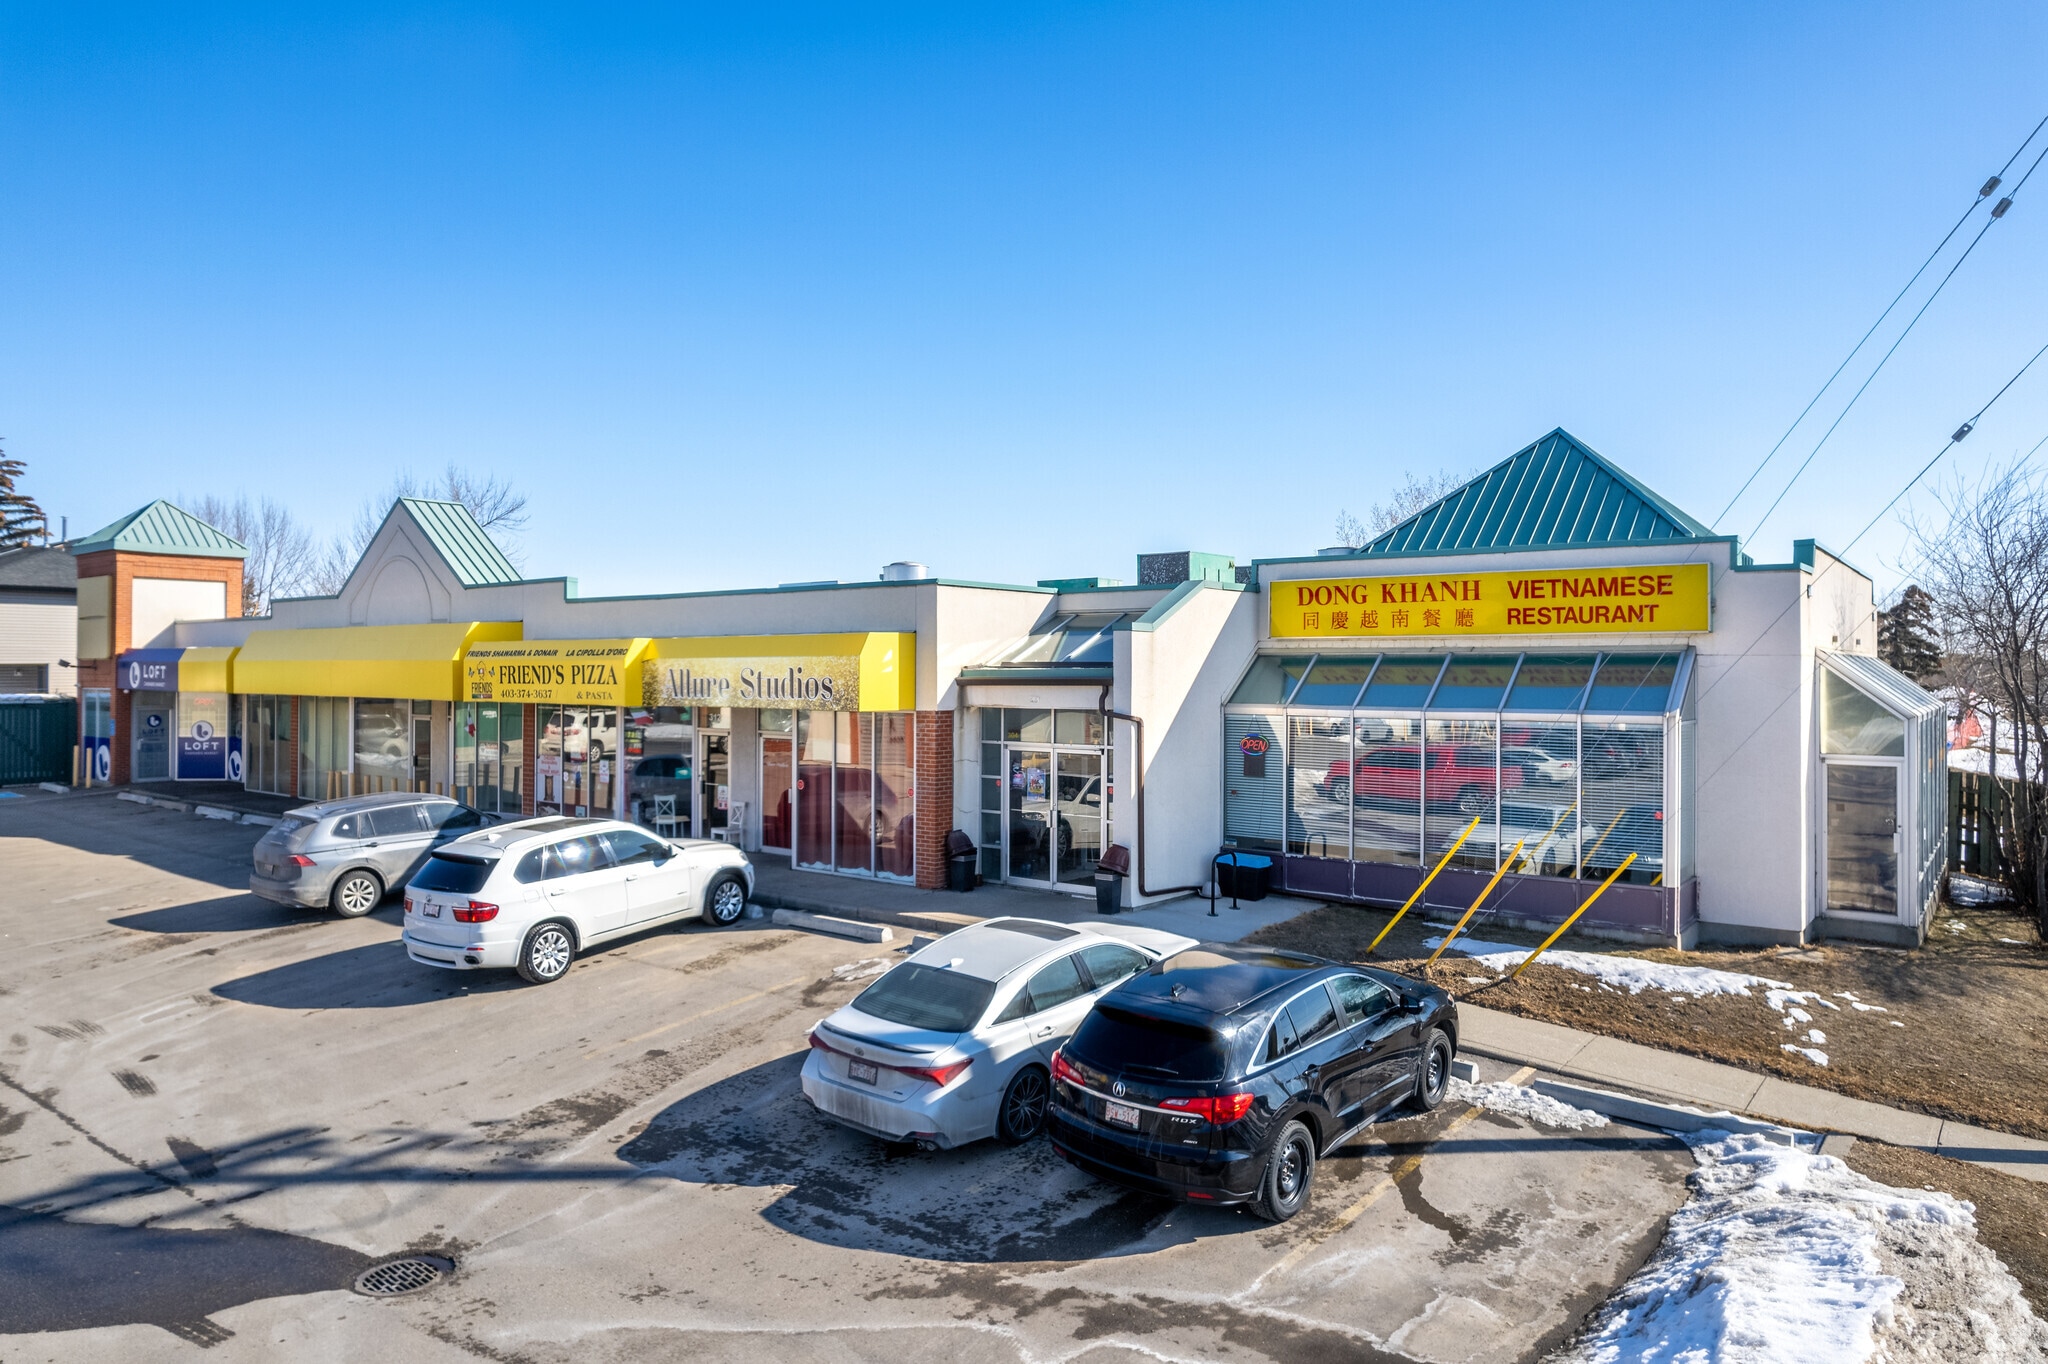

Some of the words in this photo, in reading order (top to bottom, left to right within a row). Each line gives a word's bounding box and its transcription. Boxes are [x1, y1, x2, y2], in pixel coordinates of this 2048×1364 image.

[1297, 584, 1368, 606] DONG
[1381, 580, 1481, 604] KHANH
[1507, 575, 1673, 599] VIETNAMESE
[1303, 608, 1475, 630] 同慶越南餐廳
[1507, 604, 1659, 625] RESTAURANT
[143, 665, 166, 679] LOFT
[500, 665, 564, 685] FRIEND'S
[571, 664, 617, 685] PIZZA
[471, 682, 493, 693] FRIENDS
[663, 668, 730, 699] Allure
[740, 666, 833, 700] Studios
[501, 689, 552, 699] 403-374-3637
[576, 691, 583, 699] &
[586, 691, 613, 700] PASTA
[184, 742, 219, 751] LOFT
[1242, 739, 1266, 751] OPEN
